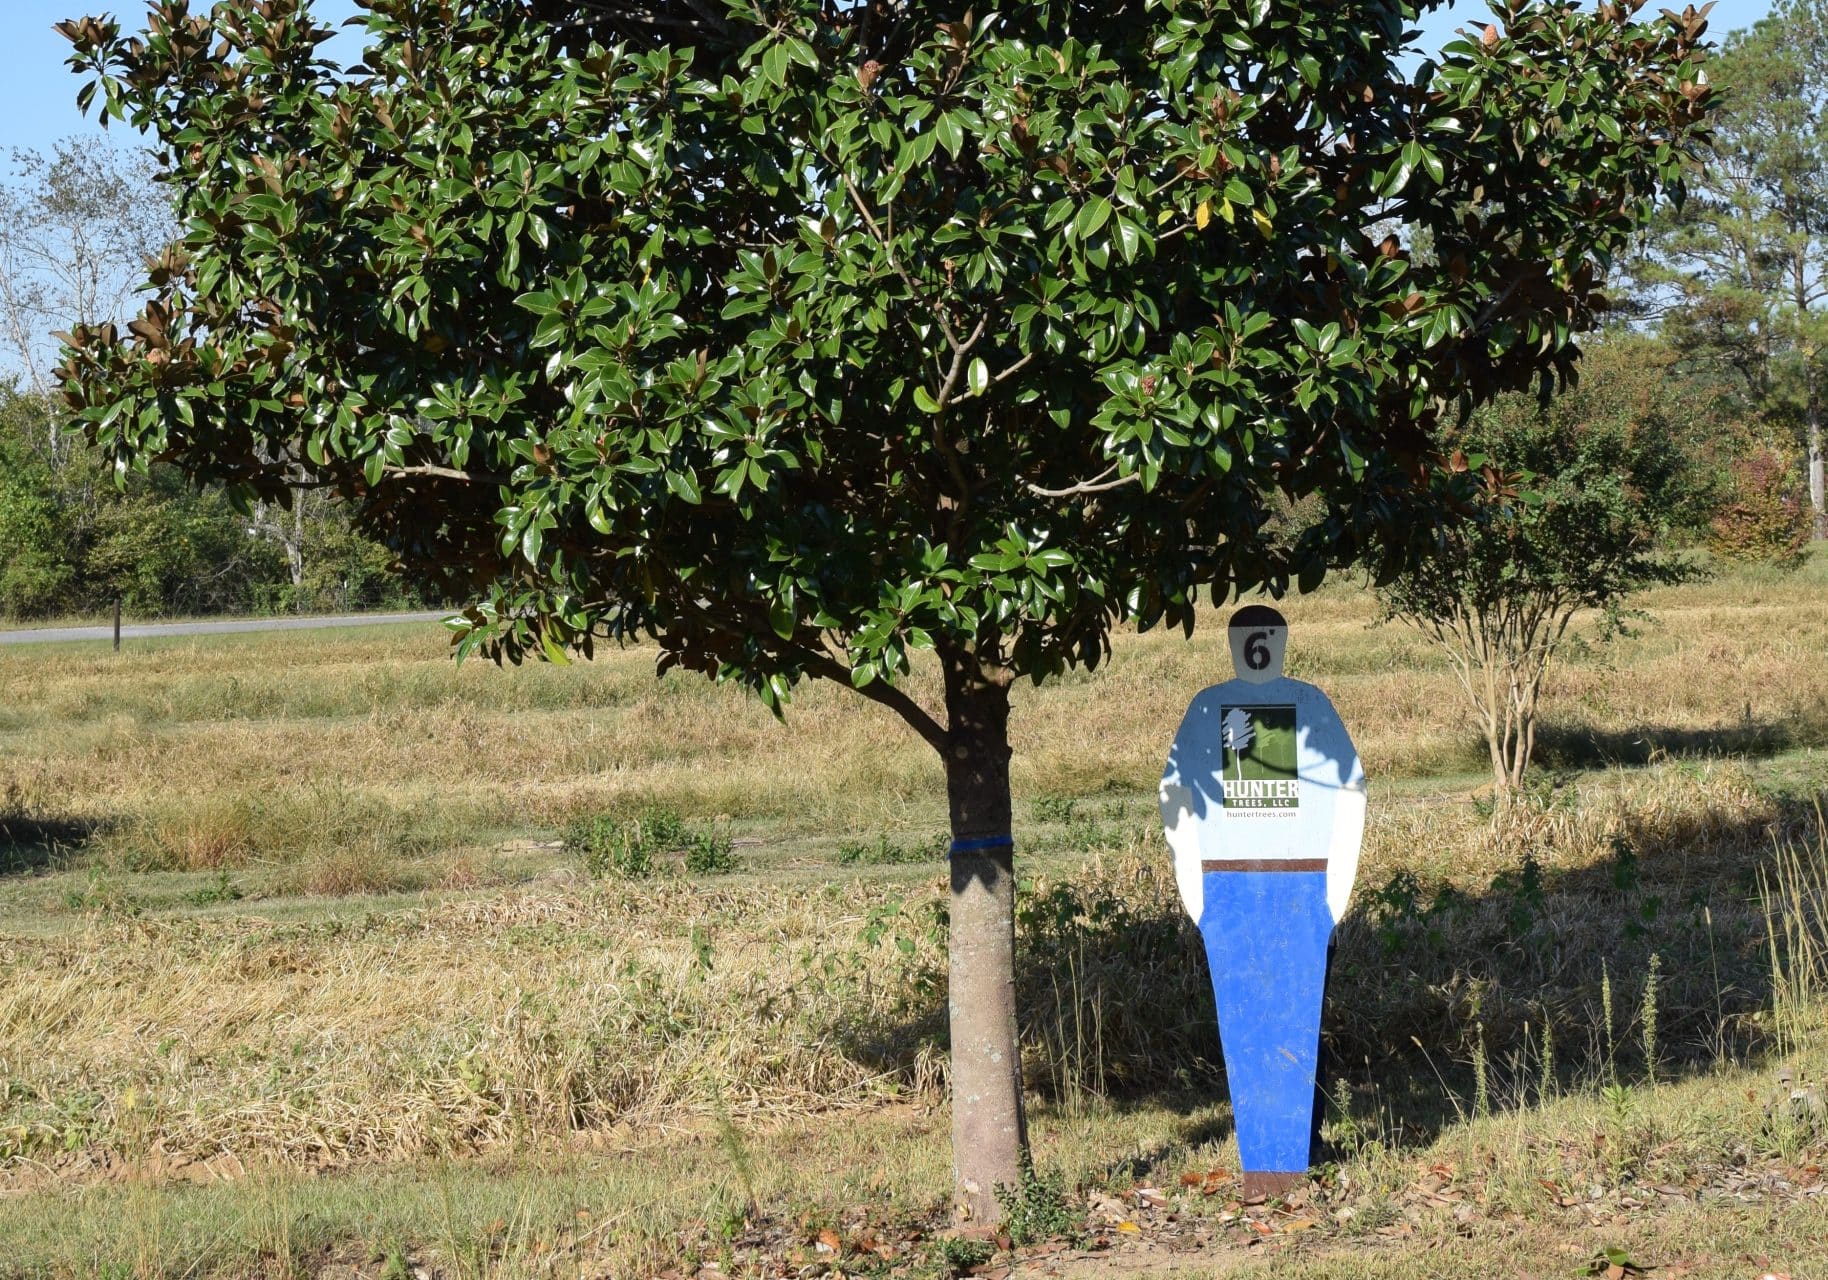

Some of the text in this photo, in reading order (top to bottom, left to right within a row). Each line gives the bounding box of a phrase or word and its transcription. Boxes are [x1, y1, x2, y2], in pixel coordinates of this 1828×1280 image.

[1224, 780, 1299, 797] HUNTER
[1272, 799, 1290, 807] LLC
[1226, 810, 1297, 818] huntertrees.com
